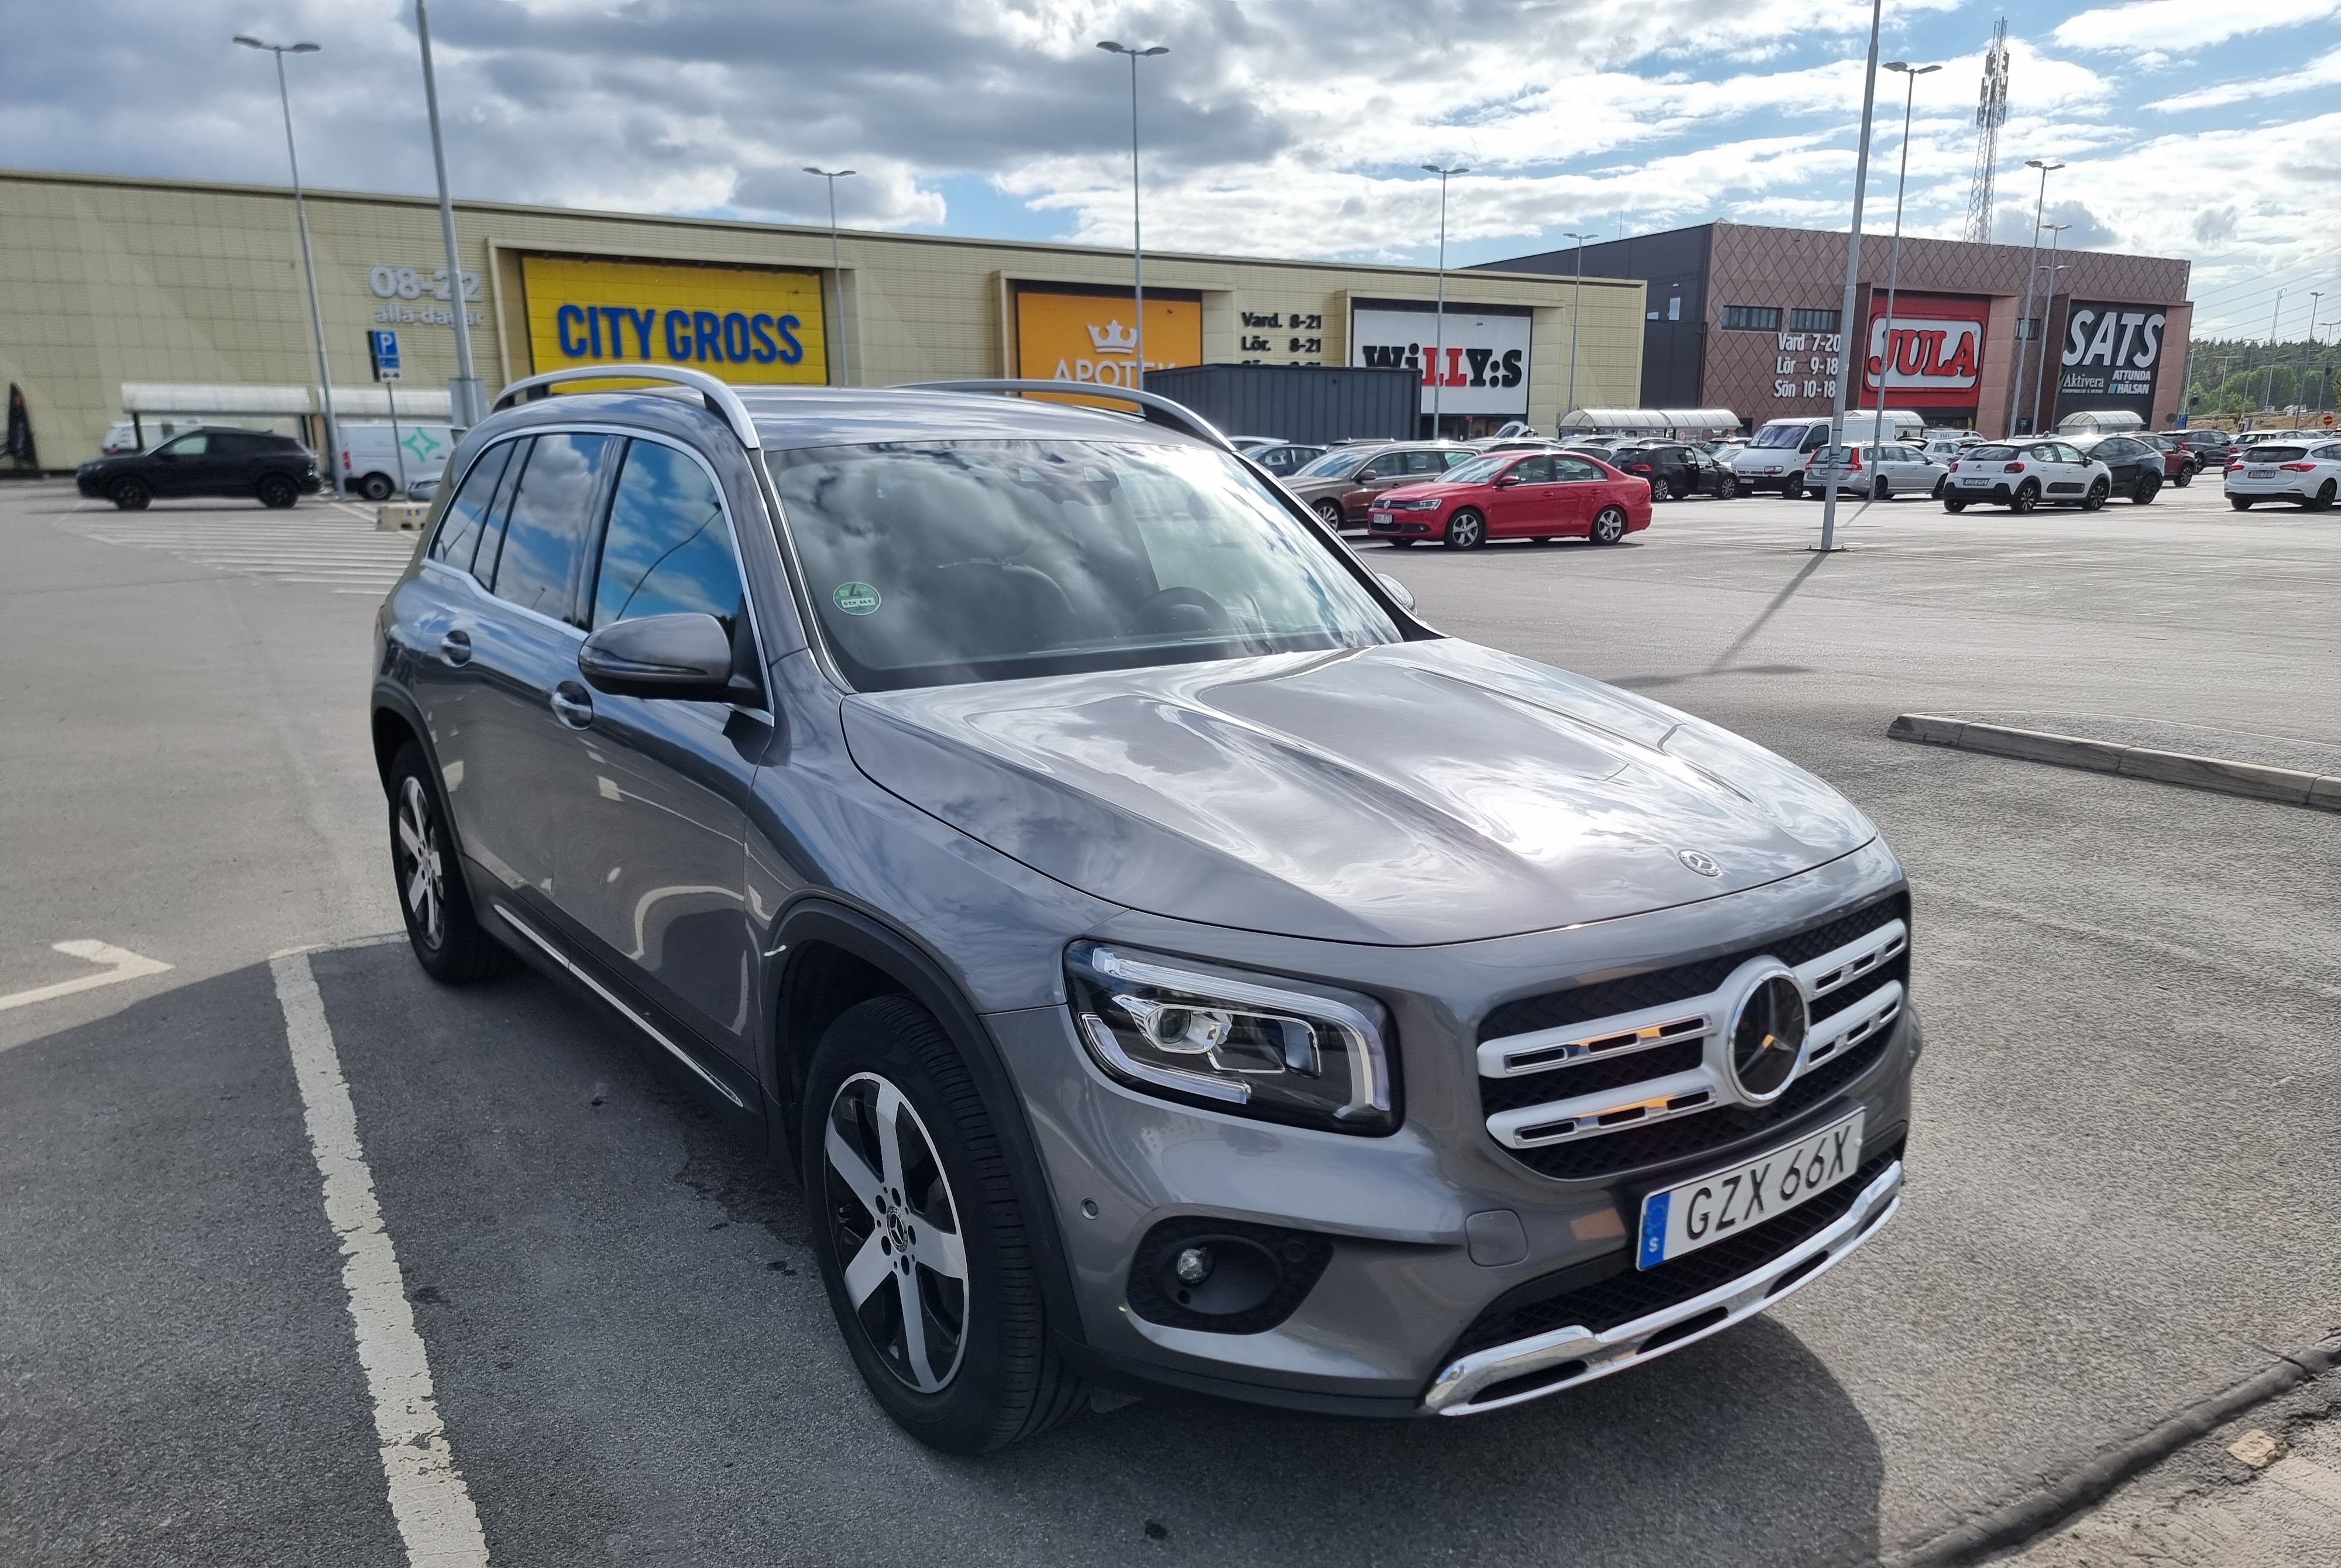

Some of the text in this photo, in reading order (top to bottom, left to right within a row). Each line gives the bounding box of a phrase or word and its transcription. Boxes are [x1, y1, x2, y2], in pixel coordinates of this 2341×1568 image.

[375, 304, 414, 323] alla
[1241, 312, 1321, 330] Vard. 8-21
[558, 304, 804, 365] CITY GROSS
[1241, 335, 1321, 353] Lör. 8-21
[1777, 332, 1841, 352] Vard 7-20
[2061, 310, 2166, 368] SATS
[379, 334, 393, 355] P
[1868, 328, 1978, 377] JULA
[1776, 356, 1839, 375] Lör 9-18
[2063, 373, 2105, 388] Aktivera
[2112, 370, 2151, 381] ATTUNDA
[1773, 379, 1837, 399] Sön 10-18
[2116, 381, 2150, 395] HÄLSAN
[1686, 1125, 1851, 1240] GZX 66X
[1648, 1237, 1659, 1253] S
